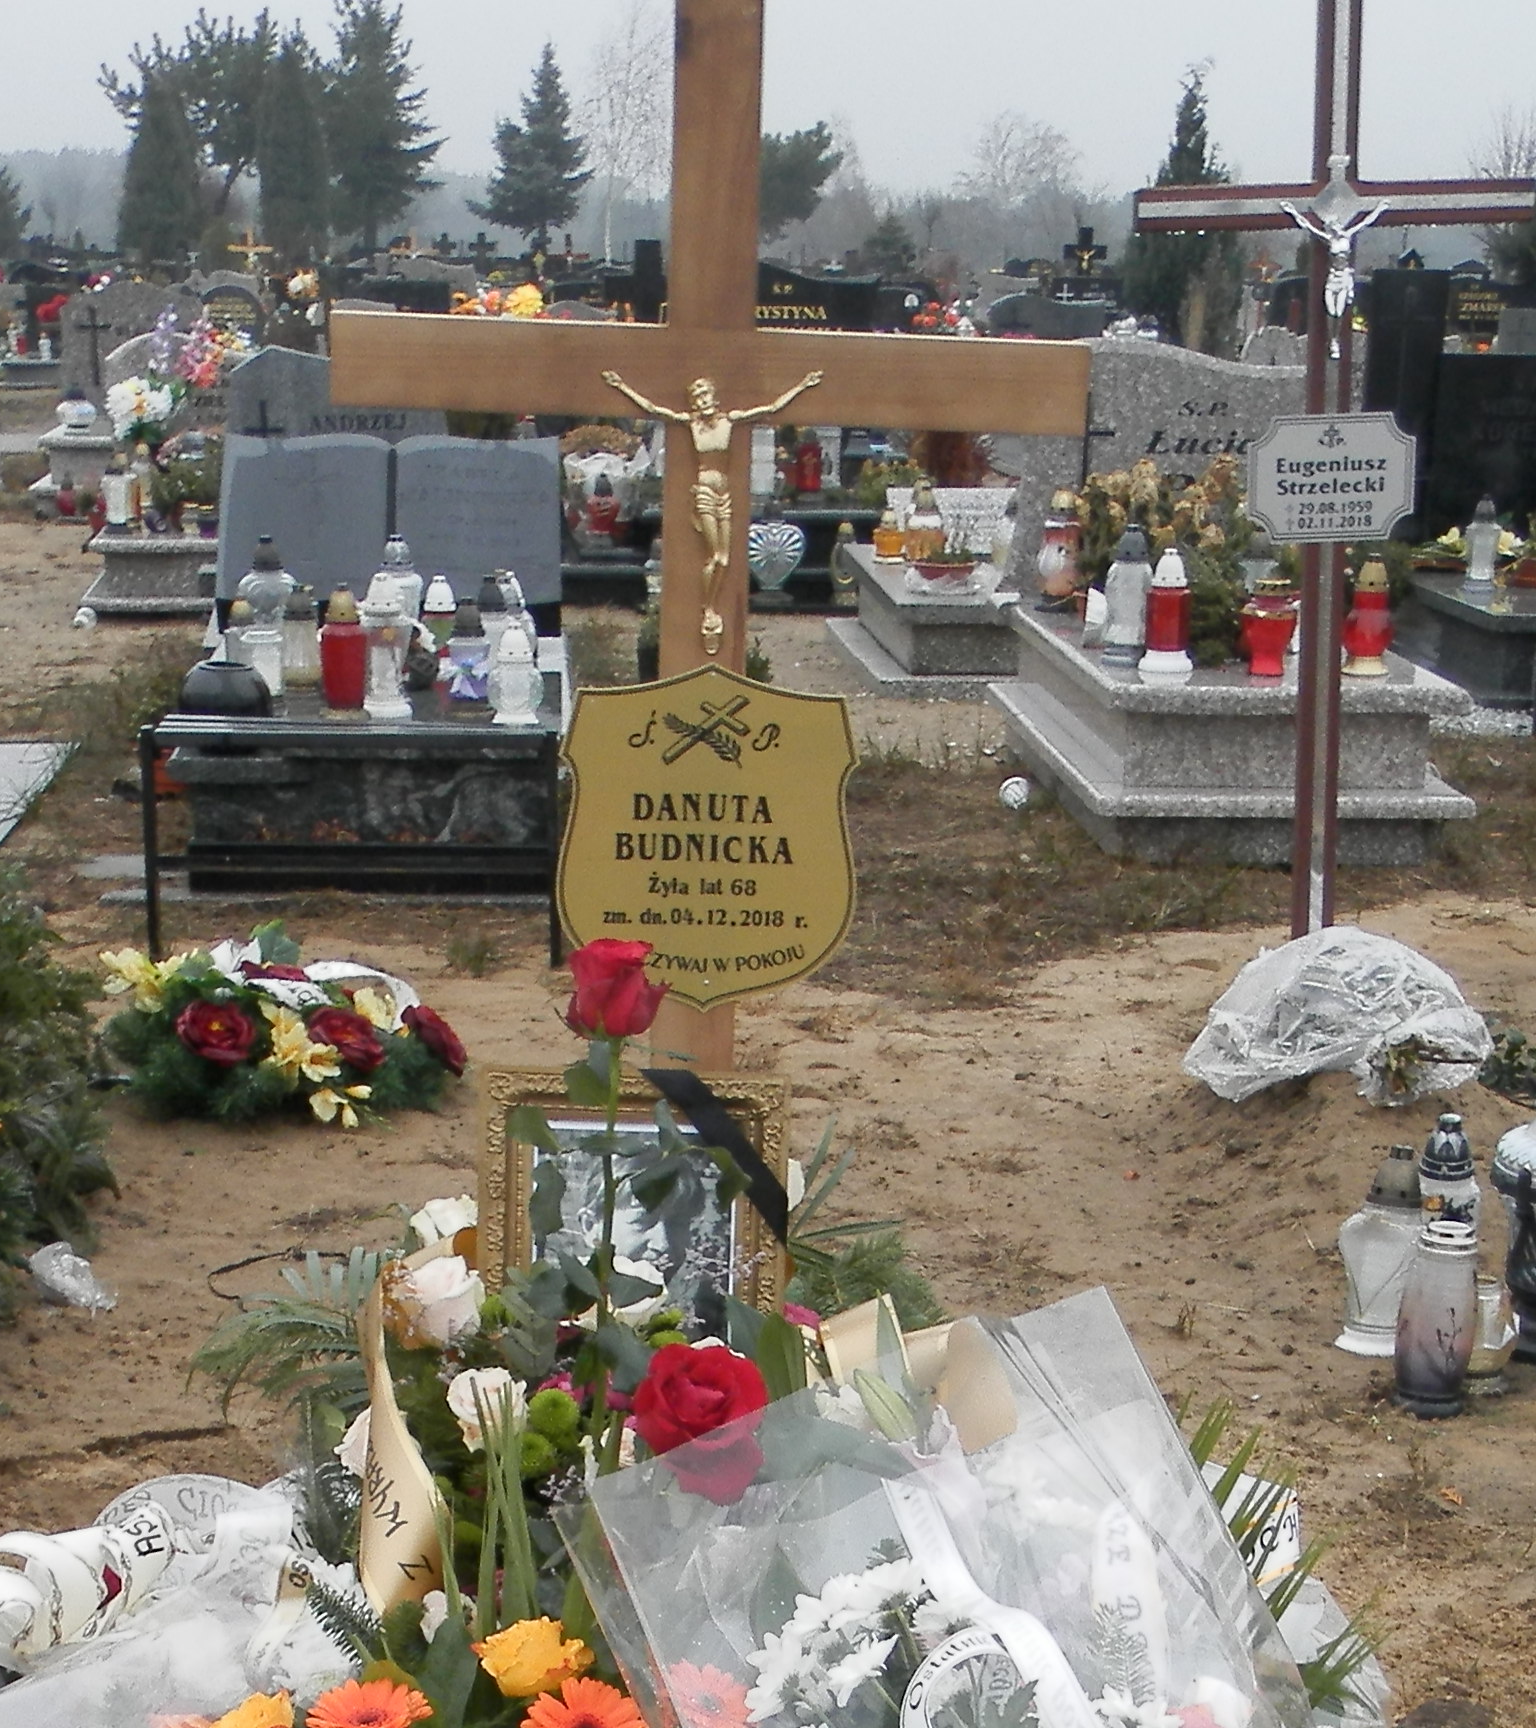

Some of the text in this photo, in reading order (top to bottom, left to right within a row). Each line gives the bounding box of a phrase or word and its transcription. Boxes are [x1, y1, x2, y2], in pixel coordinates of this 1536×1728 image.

[755, 305, 827, 321] RYSTYNA
[1276, 456, 1387, 477] Eugeniusz
[1276, 477, 1385, 496] Strzelecki
[1298, 500, 1373, 515] 29.08.1959
[1297, 516, 1372, 530] 02.11.2018
[632, 793, 773, 824] DANUTA
[615, 832, 794, 864] BUDNICKA
[648, 871, 757, 898] Żyła lat 68
[603, 910, 632, 924] zm.
[795, 913, 808, 928] r.
[645, 944, 806, 973] ZYWAJ W POKOJU
